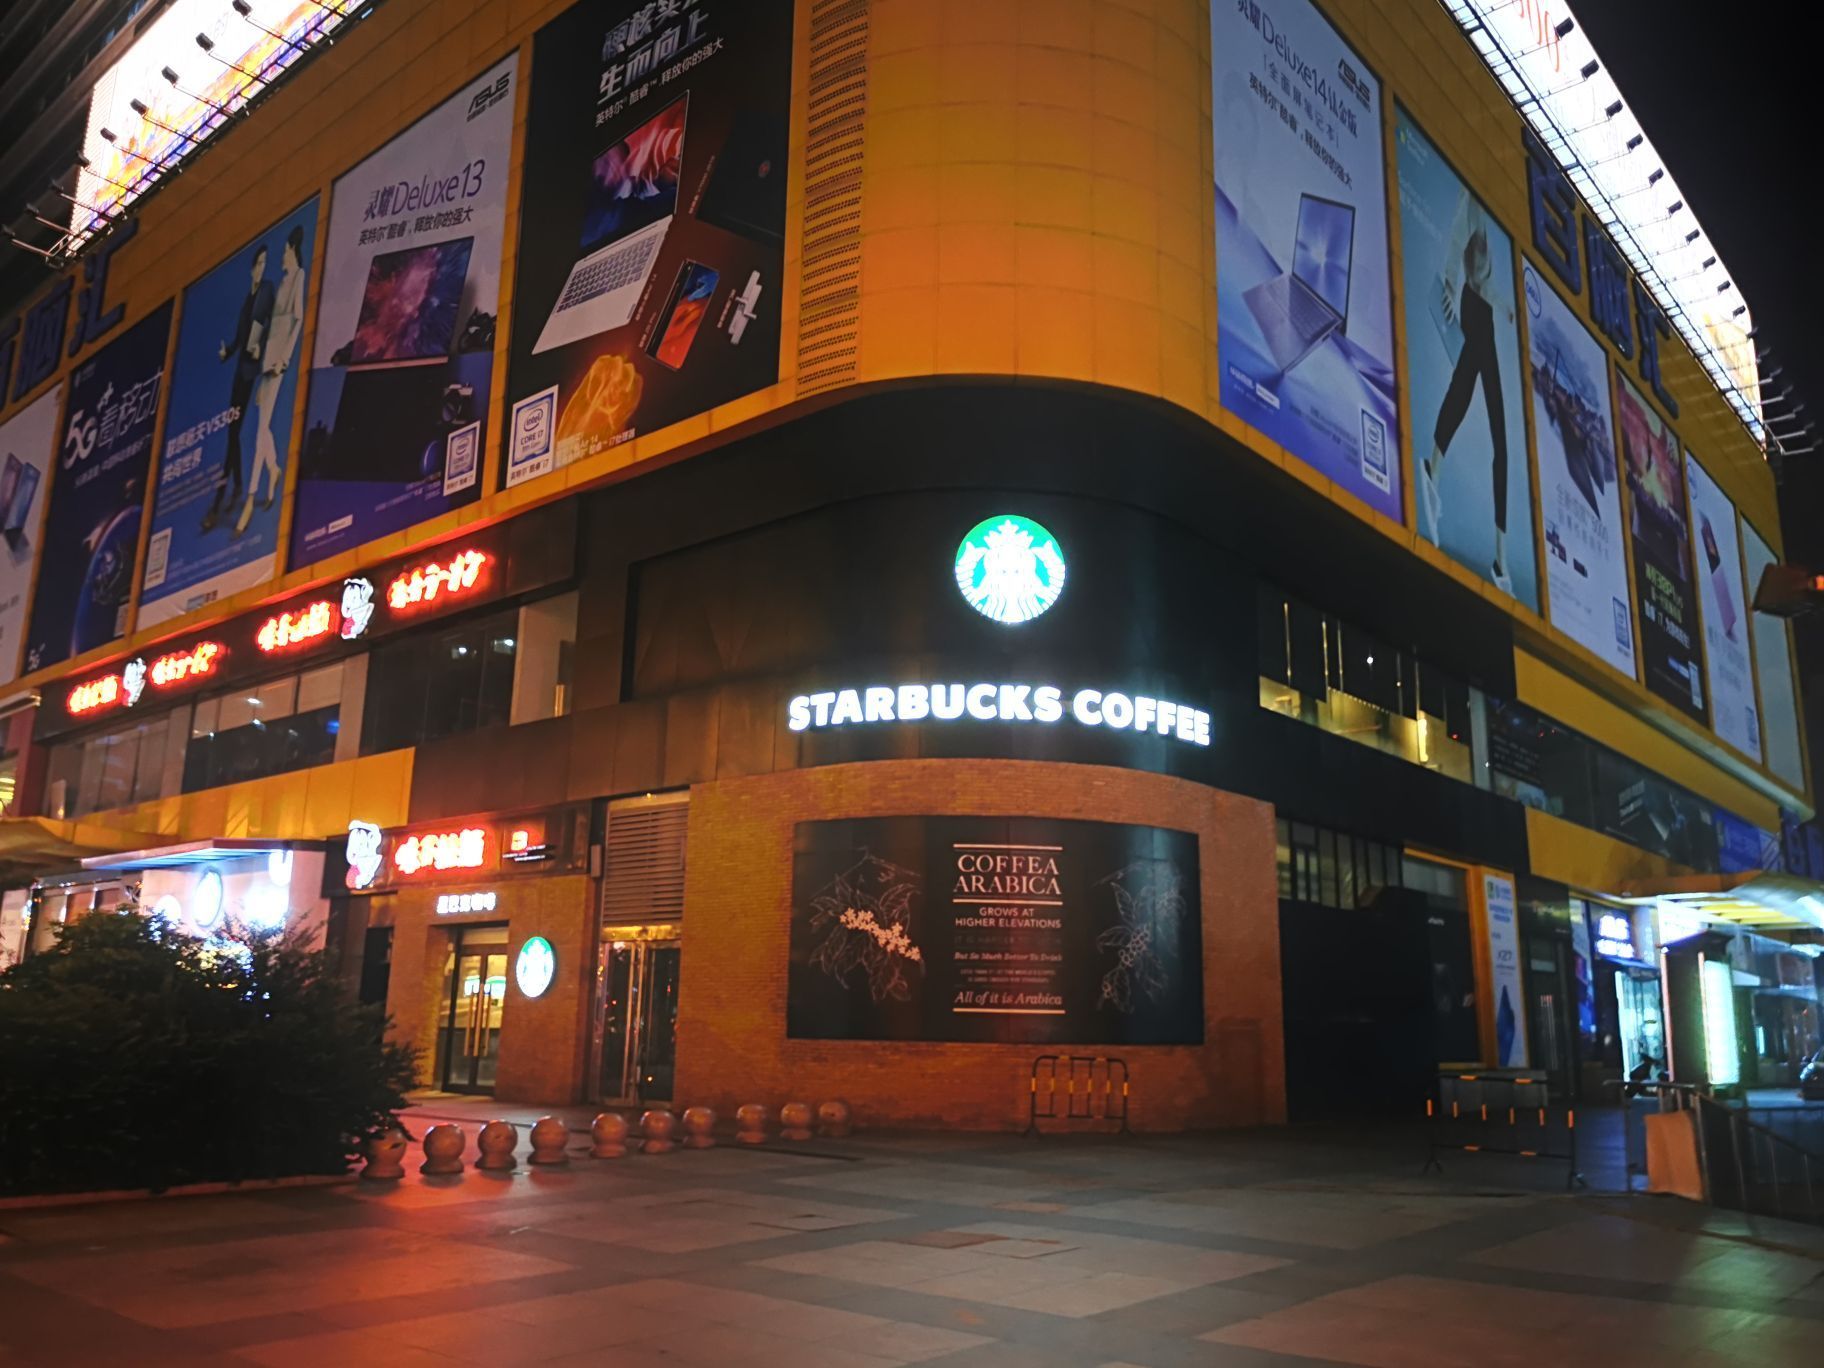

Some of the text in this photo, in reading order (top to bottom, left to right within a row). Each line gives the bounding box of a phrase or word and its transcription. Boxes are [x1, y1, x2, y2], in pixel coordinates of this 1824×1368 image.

[597, 8, 709, 104] 生而向上
[789, 683, 1211, 746] STARBUCKS COFFEE
[957, 854, 1060, 876] COFFEA
[953, 874, 1062, 895] ARABICA
[979, 907, 1035, 917] GROWS AT
[955, 917, 1062, 929] HIGHER ELEVATIONS
[954, 991, 1063, 1006] All of it is Arabica
